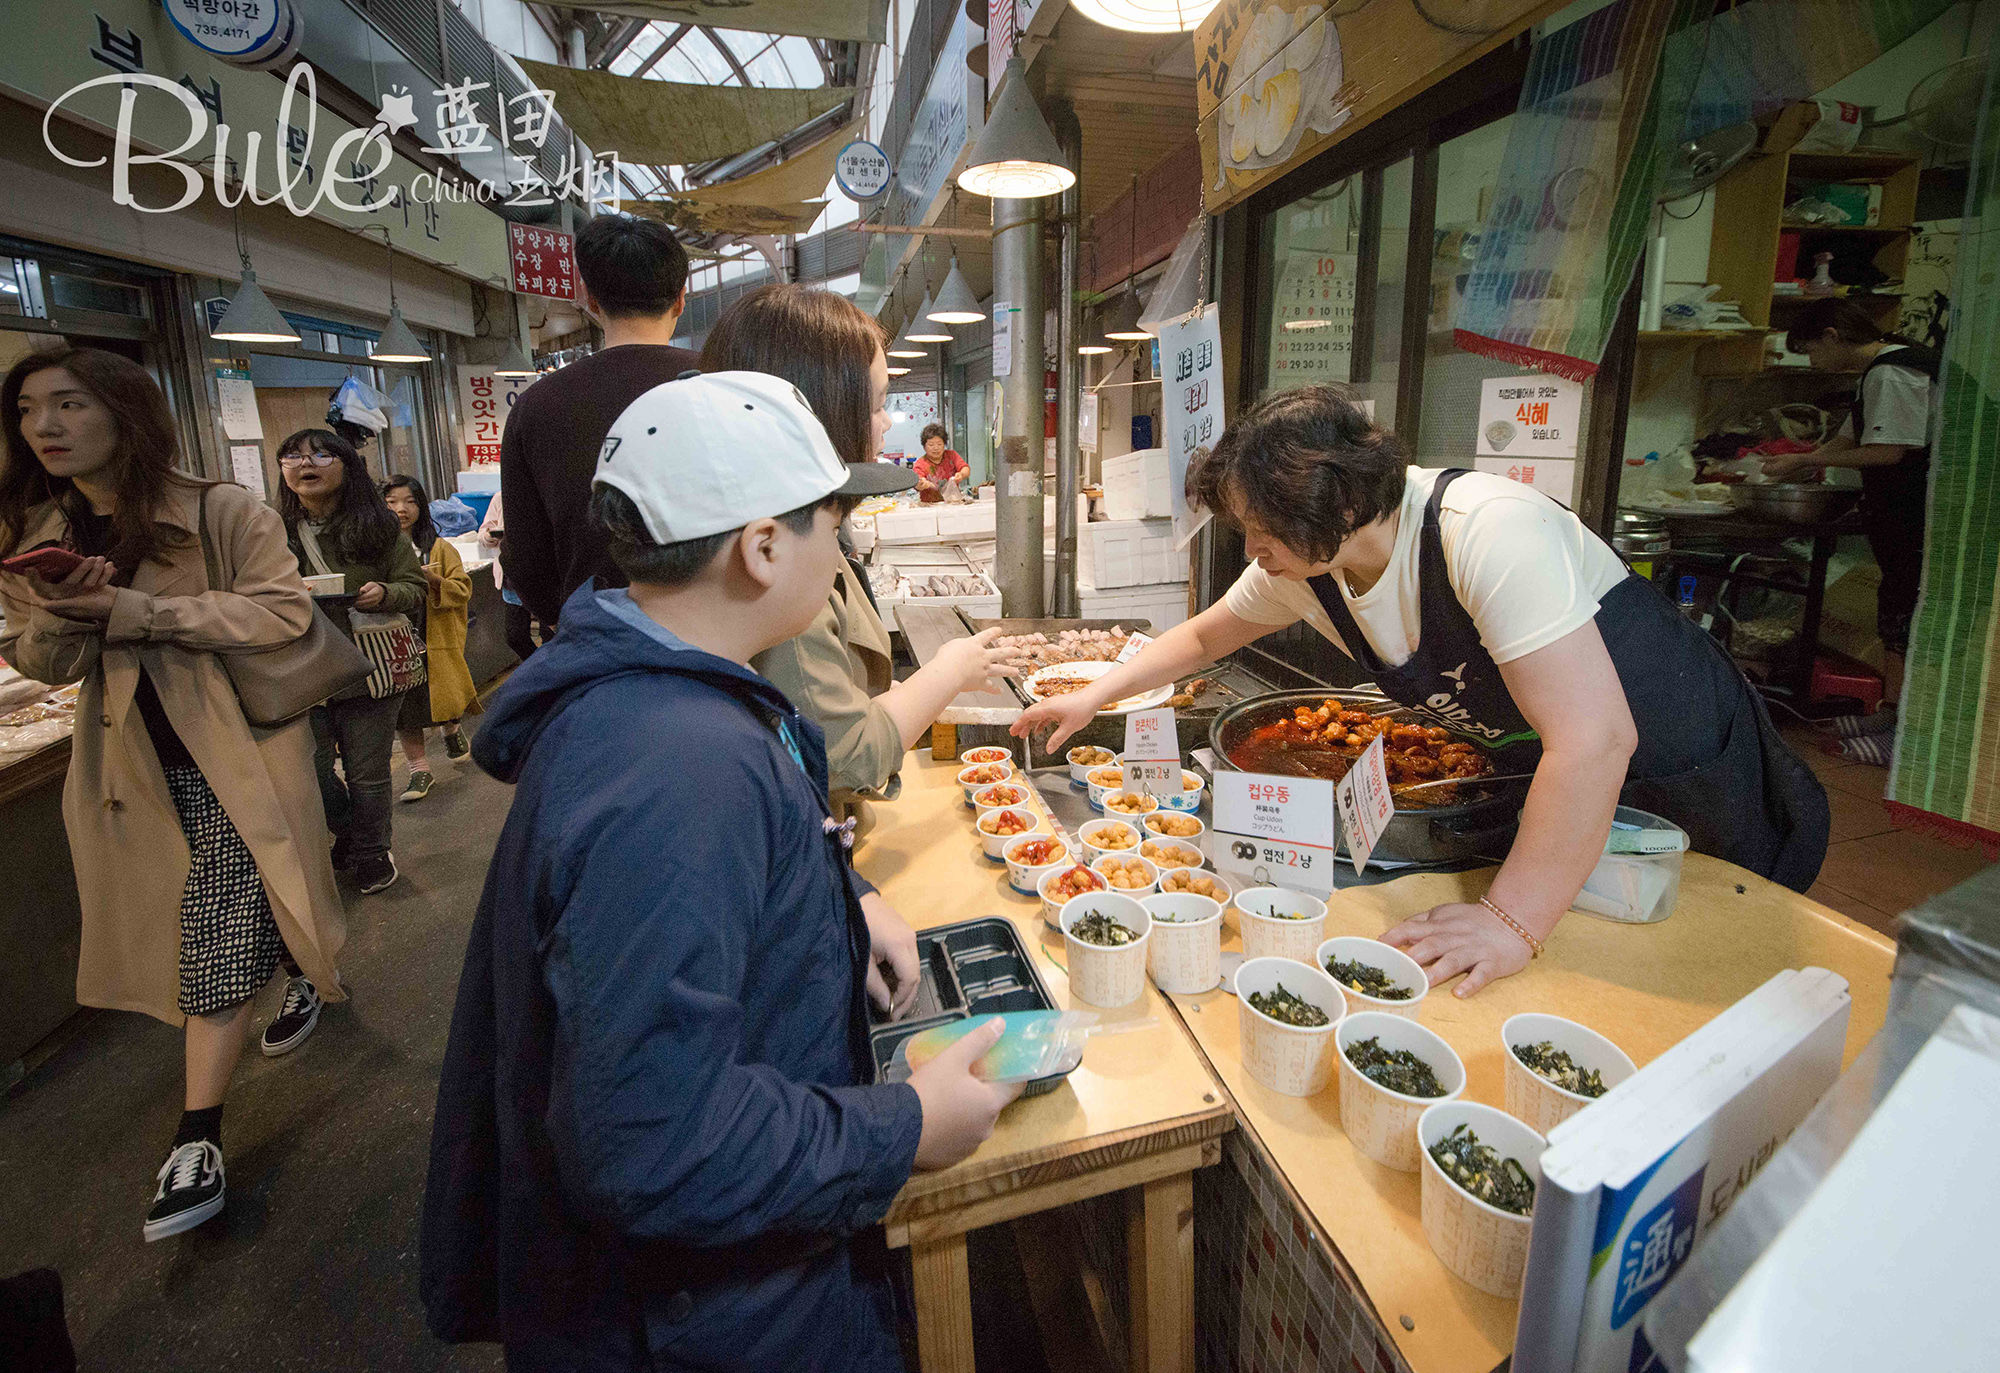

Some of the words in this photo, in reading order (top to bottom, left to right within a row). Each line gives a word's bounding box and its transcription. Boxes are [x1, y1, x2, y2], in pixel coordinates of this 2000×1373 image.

[195, 24, 250, 39] 735.4171
[842, 156, 885, 168] 서울수산물
[513, 227, 530, 291] 탕수육
[528, 231, 543, 293] 양장피
[558, 236, 572, 296] 왕만두
[1317, 258, 1335, 275] 10
[1309, 289, 1315, 298] 2
[1336, 290, 1342, 298] 4
[1348, 291, 1353, 299] 5
[1295, 307, 1301, 316] 8
[1320, 307, 1331, 316] 10
[1335, 307, 1344, 316] 11
[1334, 325, 1344, 333] 18
[1278, 342, 1288, 352] 21
[1290, 343, 1301, 352] 22
[1304, 343, 1315, 352] 23
[1317, 342, 1330, 352] 24
[1333, 342, 1344, 351] 25
[1276, 360, 1288, 369] 28
[1290, 361, 1301, 369] 29
[1303, 360, 1314, 369] 30
[1317, 360, 1328, 369] 31
[1498, 387, 1536, 399] 직접만들어서
[1538, 386, 1558, 398] 맛있는
[470, 376, 499, 441] 방앗간
[1516, 402, 1549, 426] 식혜
[1532, 429, 1561, 440] 있습니다.
[1135, 716, 1159, 733] 팝콘치킨
[1248, 783, 1291, 804] 컵우동
[1253, 814, 1266, 822] Cup
[1266, 815, 1283, 824] Udon
[1617, 1207, 1675, 1313] 通
